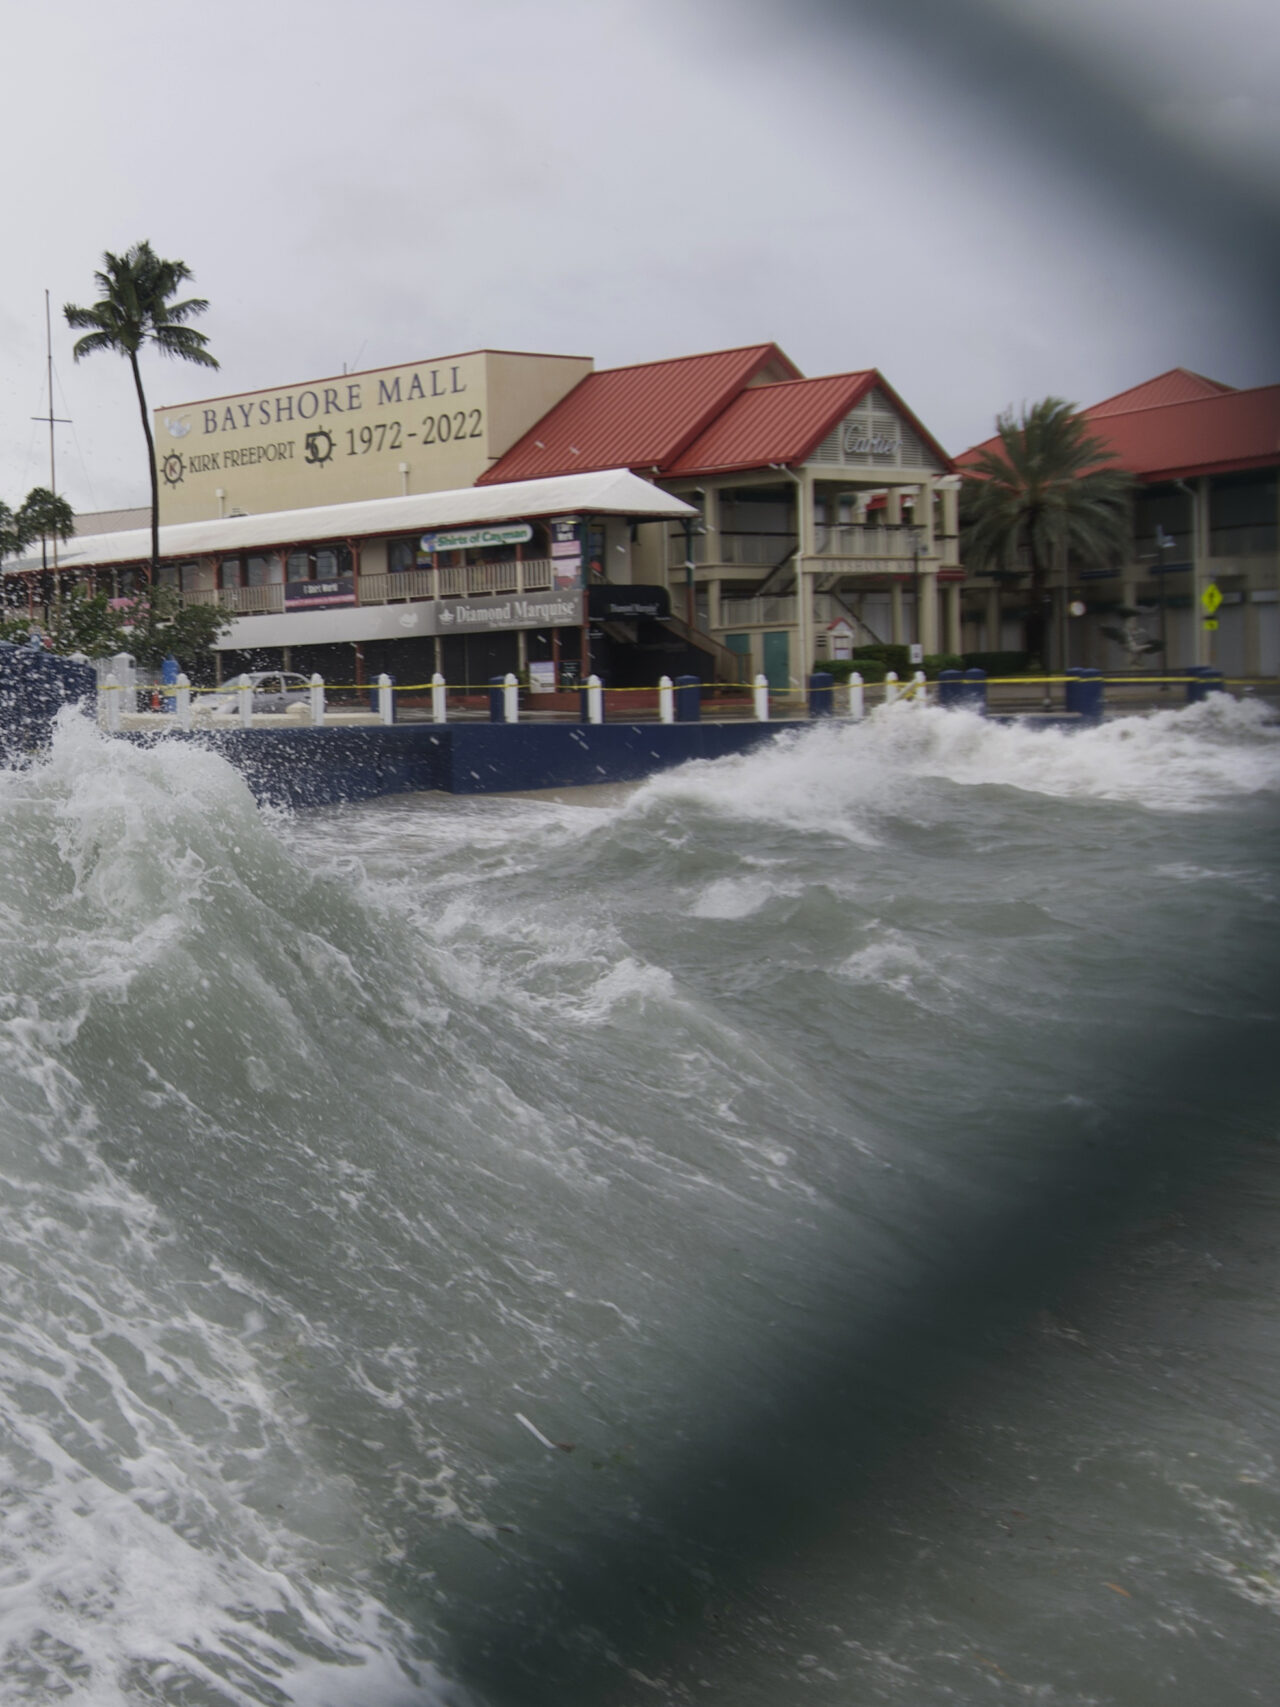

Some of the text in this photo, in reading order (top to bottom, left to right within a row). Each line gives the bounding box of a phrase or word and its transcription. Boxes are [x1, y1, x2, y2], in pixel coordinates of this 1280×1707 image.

[202, 366, 468, 435] BAYSHORE MALL
[845, 425, 902, 455] Cartier
[188, 440, 296, 474] KIRK FREEPORT
[438, 529, 528, 547] Shirts of Cayman
[456, 598, 575, 623] Diamond Marquise
